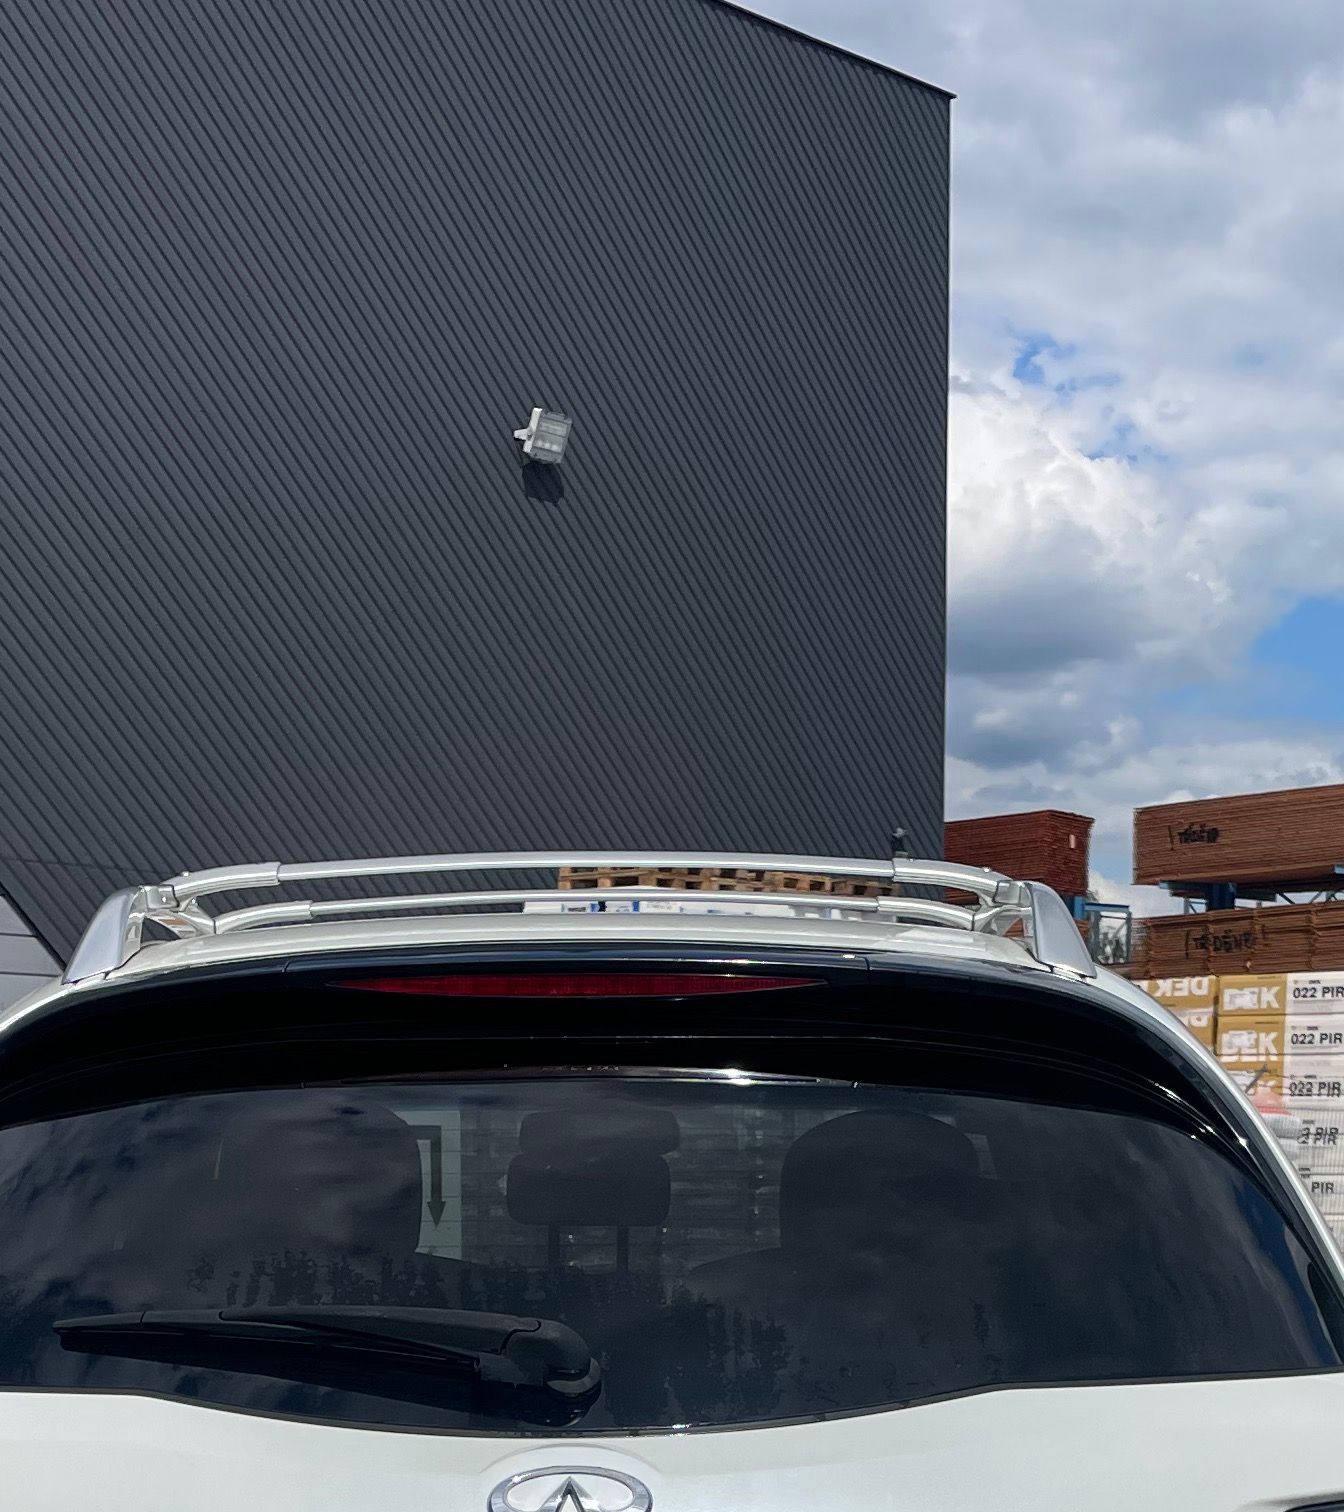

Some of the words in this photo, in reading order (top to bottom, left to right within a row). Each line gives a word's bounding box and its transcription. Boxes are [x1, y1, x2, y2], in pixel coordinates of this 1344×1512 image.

[1293, 987, 1317, 998] 022
[1322, 986, 1344, 998] PIR
[1291, 1033, 1315, 1045] 022
[1319, 1033, 1342, 1044] PIR
[1288, 1081, 1313, 1097] 022
[1317, 1081, 1341, 1097] PIR
[1311, 1182, 1334, 1193] PIR
